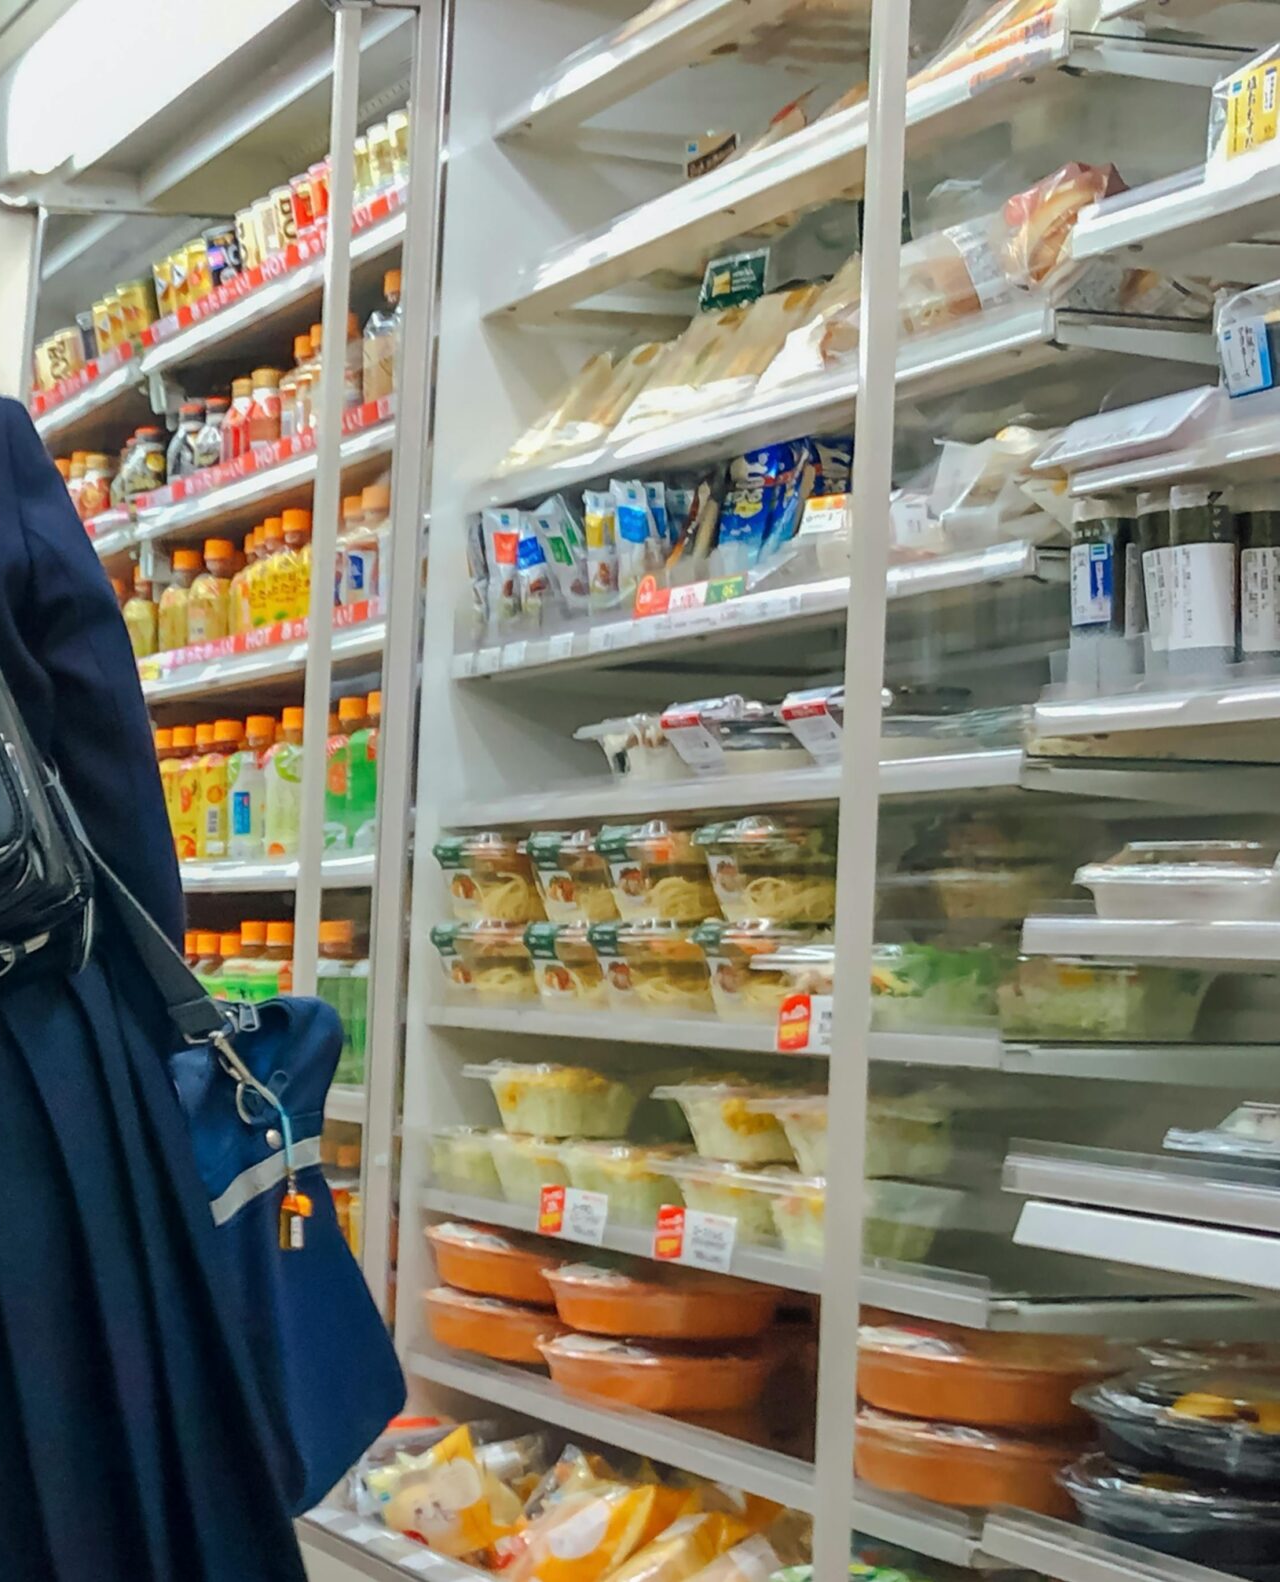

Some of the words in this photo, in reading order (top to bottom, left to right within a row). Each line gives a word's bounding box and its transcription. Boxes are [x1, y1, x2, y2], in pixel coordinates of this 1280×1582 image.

[261, 253, 288, 281] HOT
[255, 442, 282, 468] HOT
[245, 626, 272, 649] HOT
